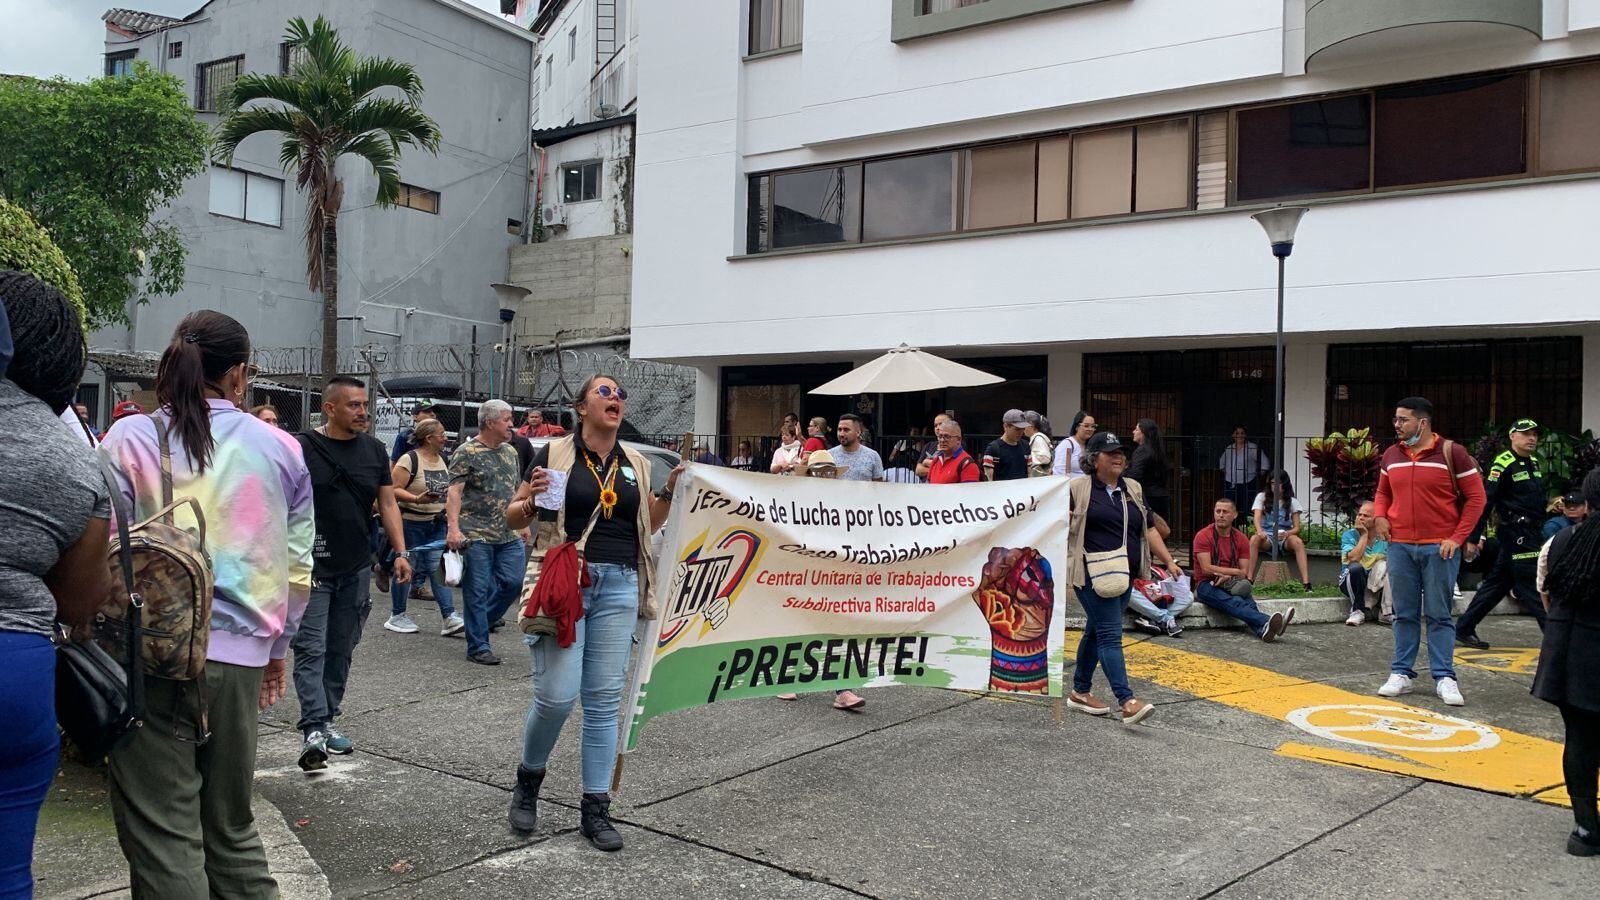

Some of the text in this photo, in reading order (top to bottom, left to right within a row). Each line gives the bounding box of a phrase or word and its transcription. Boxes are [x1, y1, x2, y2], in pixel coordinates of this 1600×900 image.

[690, 489, 732, 514] ¡En
[769, 499, 788, 524] de
[792, 501, 841, 527] Lucha
[845, 508, 874, 532] por
[878, 504, 904, 527] los
[907, 502, 999, 527] Derechos
[1003, 499, 1026, 519] de
[756, 569, 975, 590] Central Unitaria de Trabajadores
[782, 596, 936, 613] Subdirectiva Risaralda
[707, 636, 929, 703] ¡PRESENTE!
